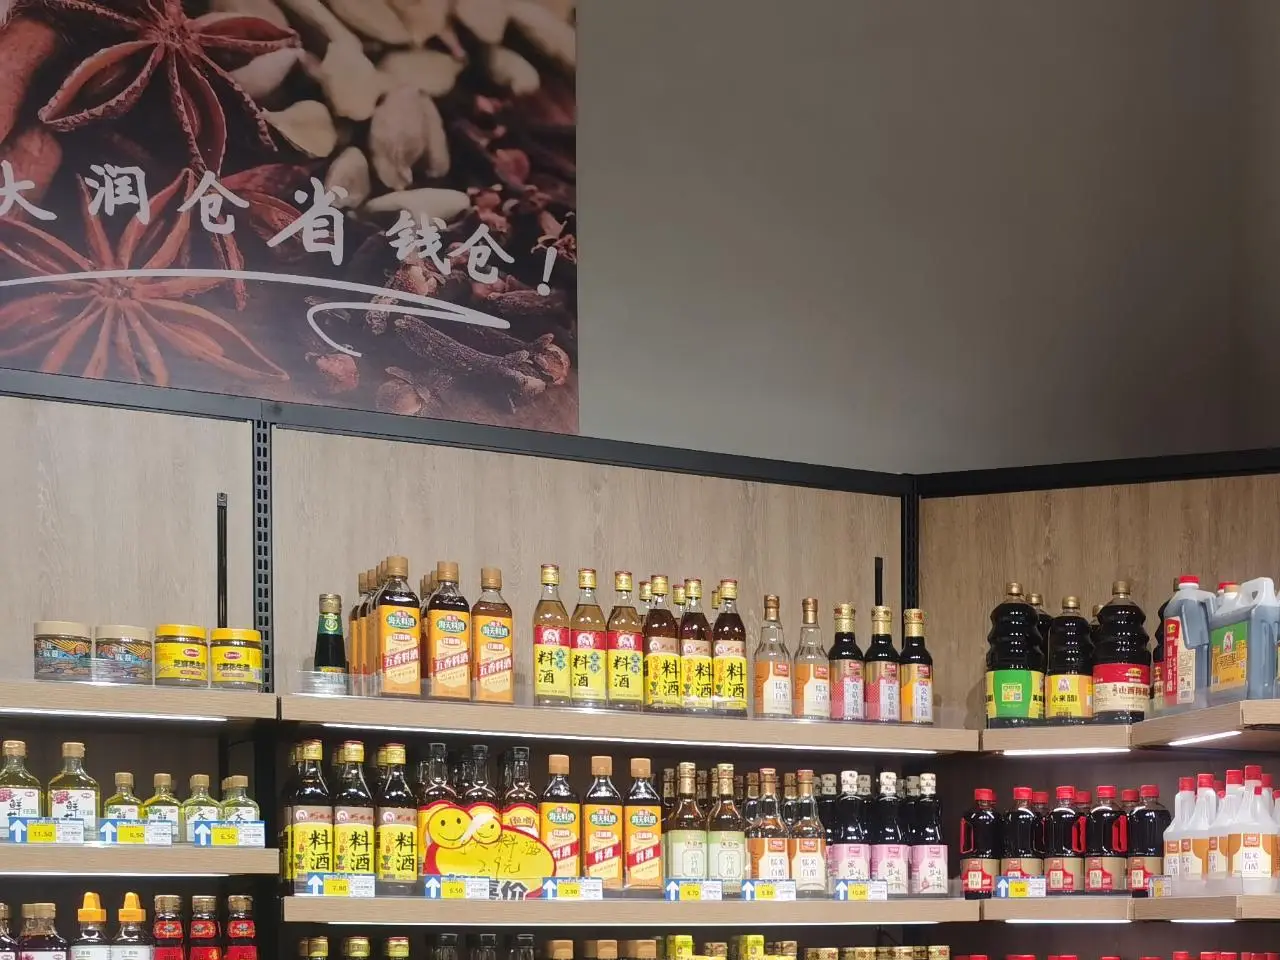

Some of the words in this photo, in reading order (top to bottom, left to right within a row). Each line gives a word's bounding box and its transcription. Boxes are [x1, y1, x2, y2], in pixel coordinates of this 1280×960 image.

[384, 651, 418, 669] 五香料酒
[434, 656, 469, 674] 五香料酒
[479, 661, 512, 678] 五香料酒
[538, 651, 556, 684] 料酒
[573, 655, 590, 688] 料酒
[613, 657, 630, 689] 料酒
[661, 659, 680, 698] 料酒
[694, 661, 713, 699] 料酒
[726, 662, 745, 699] 料酒
[309, 832, 330, 872] 料酒
[349, 832, 371, 872] 料酒
[395, 832, 416, 873] 料酒
